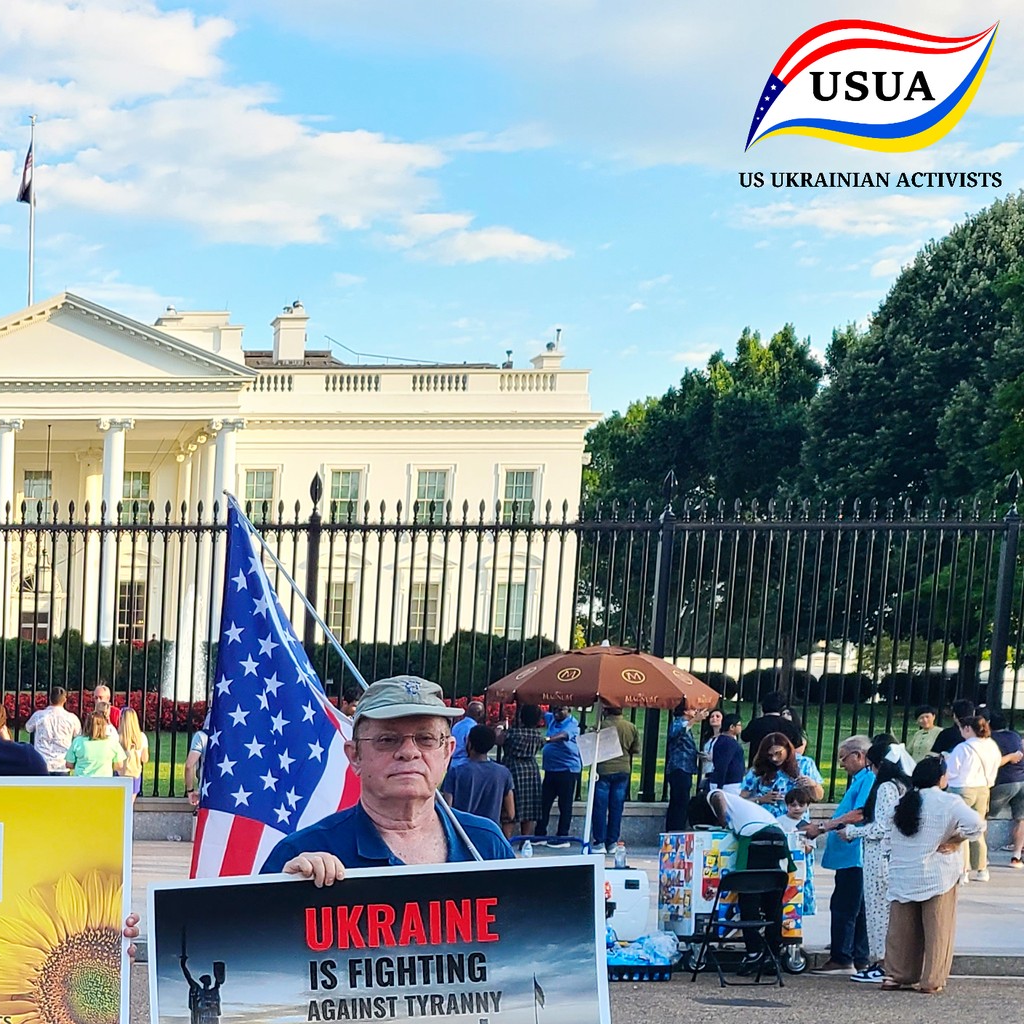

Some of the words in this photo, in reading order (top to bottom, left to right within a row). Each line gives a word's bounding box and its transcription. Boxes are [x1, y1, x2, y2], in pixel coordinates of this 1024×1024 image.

[304, 897, 500, 952] UKRAINE
[309, 959, 337, 991] IS
[348, 952, 488, 989] FIGHTING
[307, 996, 396, 1022] AGAINST
[401, 991, 504, 1016] TYRANNY
